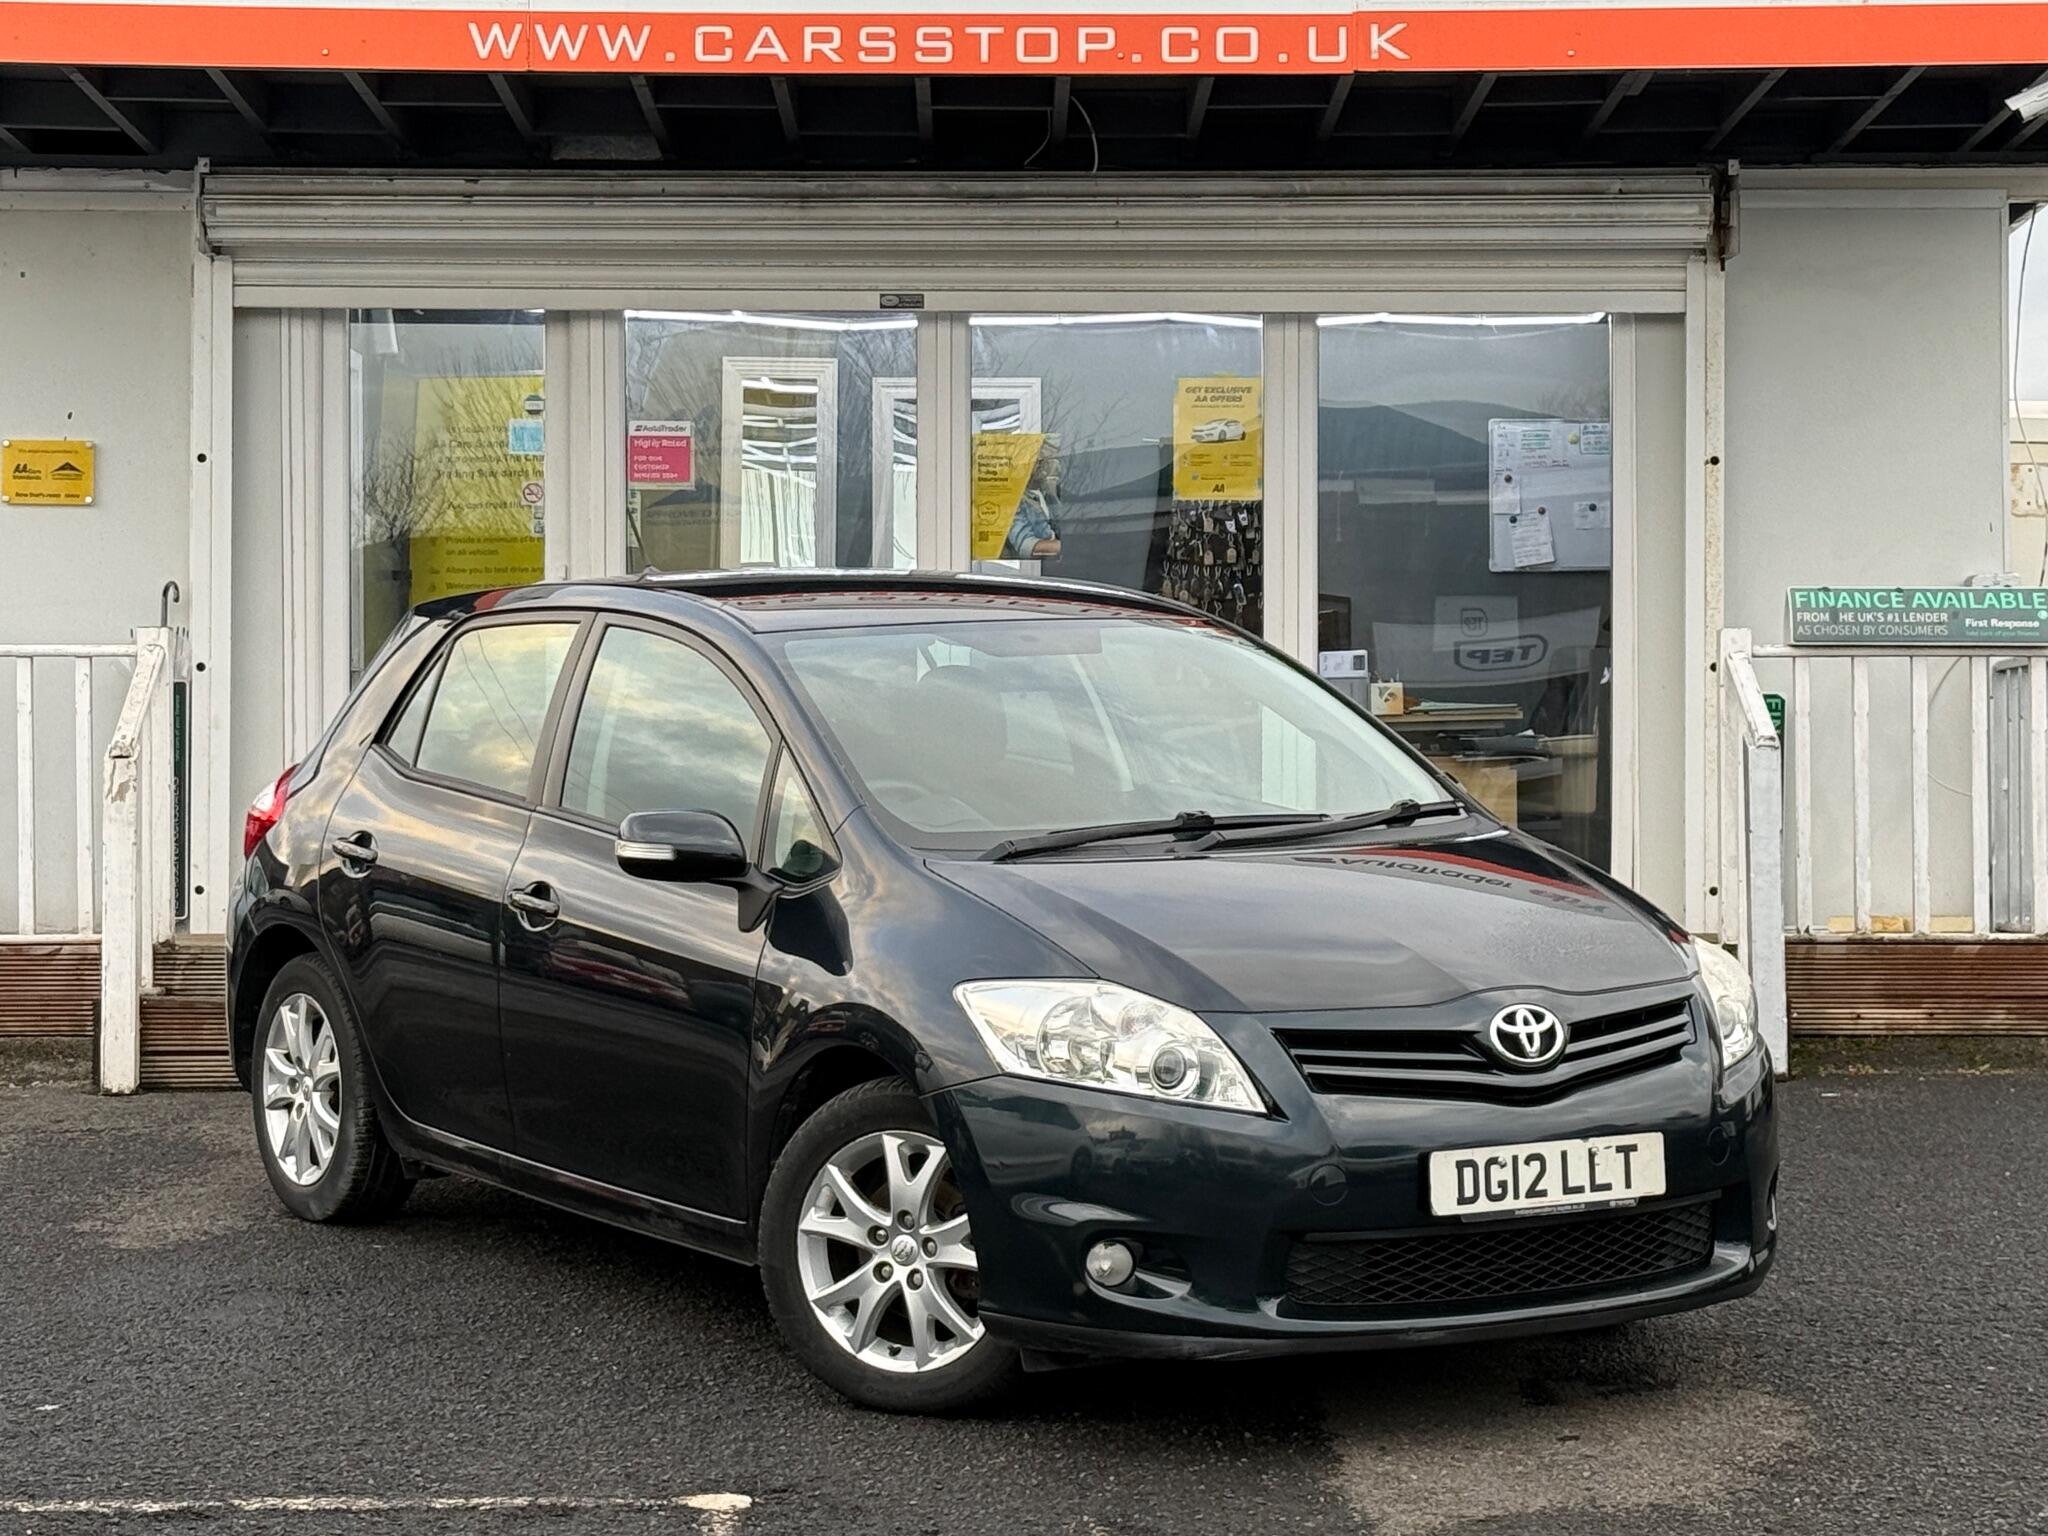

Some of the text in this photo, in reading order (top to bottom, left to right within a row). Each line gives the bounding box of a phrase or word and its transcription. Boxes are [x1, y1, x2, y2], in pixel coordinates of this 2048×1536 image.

[1185, 386, 1252, 394] GET EXCLUSIVE
[1194, 395, 1242, 403] AA OFFERS
[634, 438, 660, 448] Highly
[1212, 484, 1225, 493] AA
[446, 536, 475, 544] Provide
[446, 566, 468, 574] Allow
[469, 567, 482, 575] you
[510, 566, 530, 574] drive
[1794, 590, 2048, 609] FINANCE AVAILABLE
[1796, 612, 1949, 624] FROM HE UK'S #1 LENDER
[1965, 618, 2040, 630] First Response
[1796, 625, 1949, 637] AS CHOSEN BY CONSUMERS
[1455, 1143, 1639, 1206] DG12 LLT
